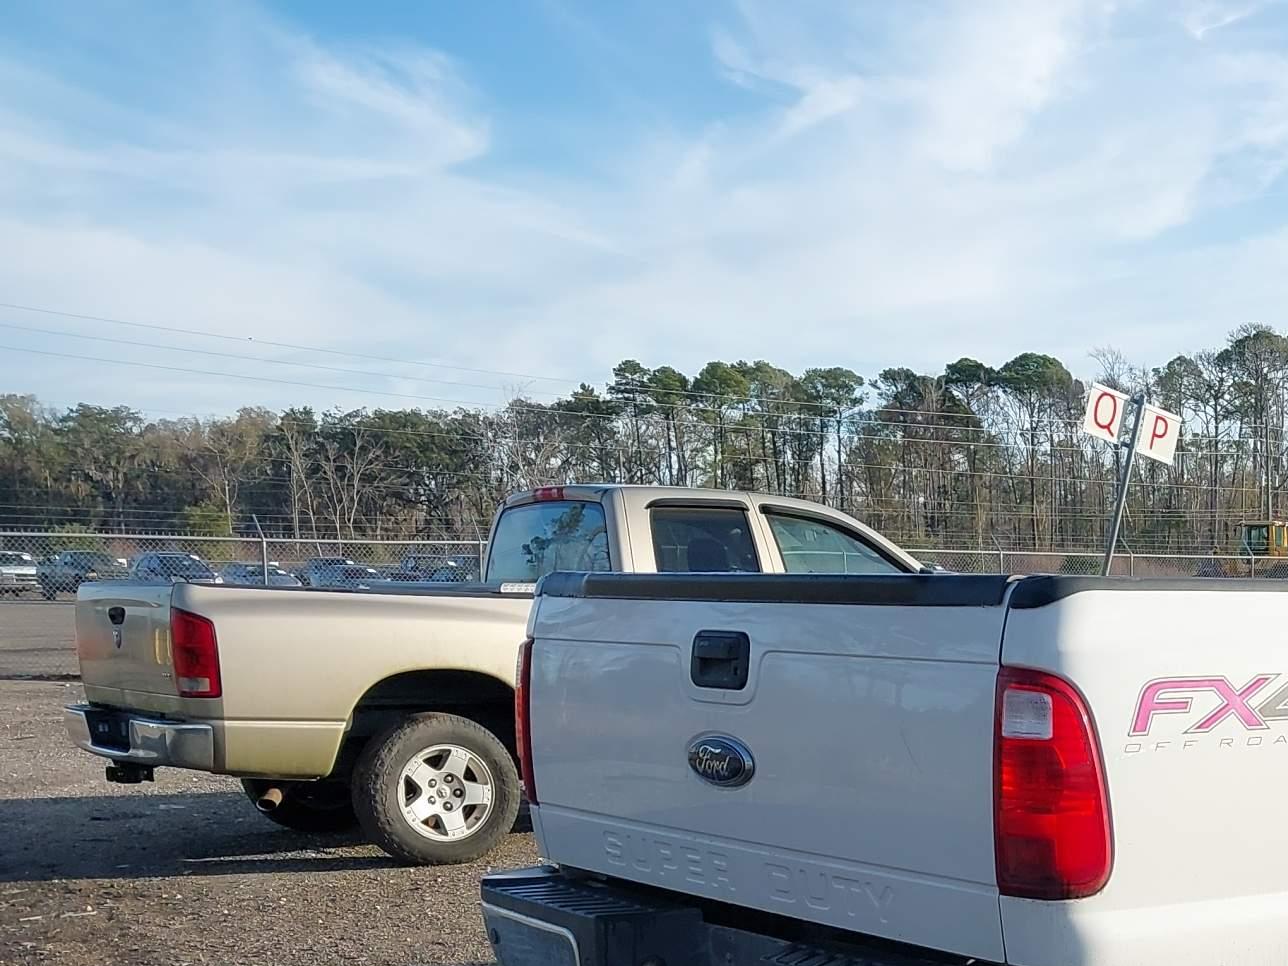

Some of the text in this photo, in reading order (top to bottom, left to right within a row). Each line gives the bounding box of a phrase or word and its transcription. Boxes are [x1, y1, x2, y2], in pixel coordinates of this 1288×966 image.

[1093, 392, 1117, 437] Q
[1150, 415, 1168, 450] P
[696, 745, 730, 777] Ford
[603, 830, 895, 924] SUPER DUTY
